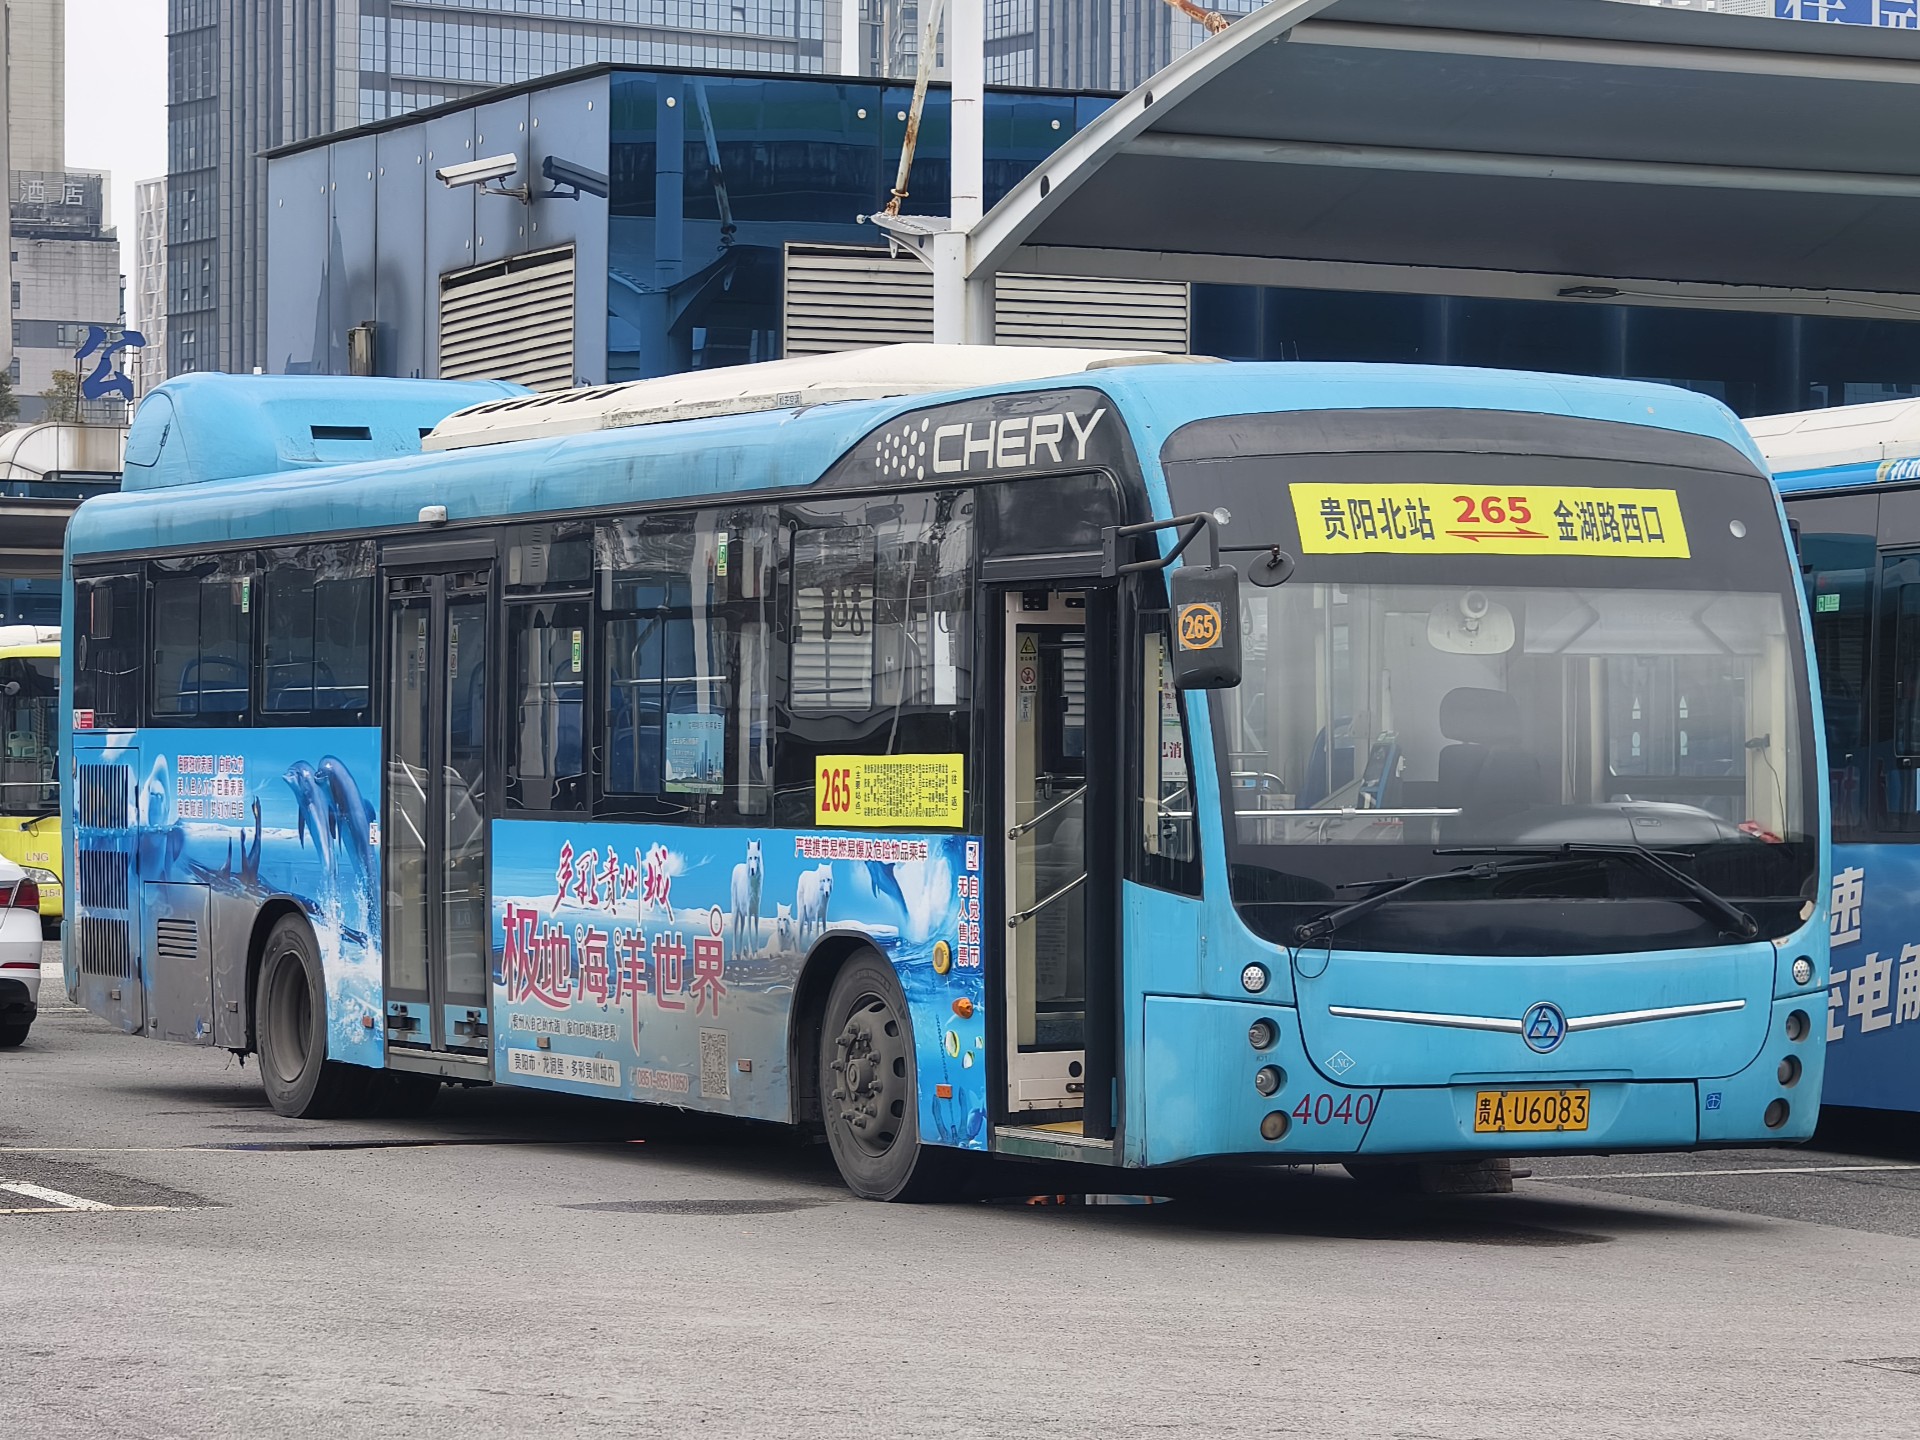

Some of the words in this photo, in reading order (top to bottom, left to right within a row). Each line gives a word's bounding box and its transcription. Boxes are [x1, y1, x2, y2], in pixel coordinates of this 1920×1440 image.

[20, 180, 84, 206] 酒店
[73, 326, 146, 402] 公
[933, 408, 1107, 474] CHERY
[1319, 497, 1436, 541] 贵阳北站
[1453, 495, 1532, 525] 265
[1553, 499, 1666, 545] 金湖路西口
[1185, 614, 1214, 640] 265
[821, 768, 850, 812] 265
[26, 853, 49, 861] LNG
[795, 836, 929, 861] 严禁携带易燃易爆及危险物品乘车
[958, 877, 969, 967] 无人售票
[969, 875, 980, 967] 自觉投币
[502, 902, 727, 1052] 极地海洋世界
[1331, 1057, 1350, 1068] LNG
[1292, 1093, 1374, 1126] 4040
